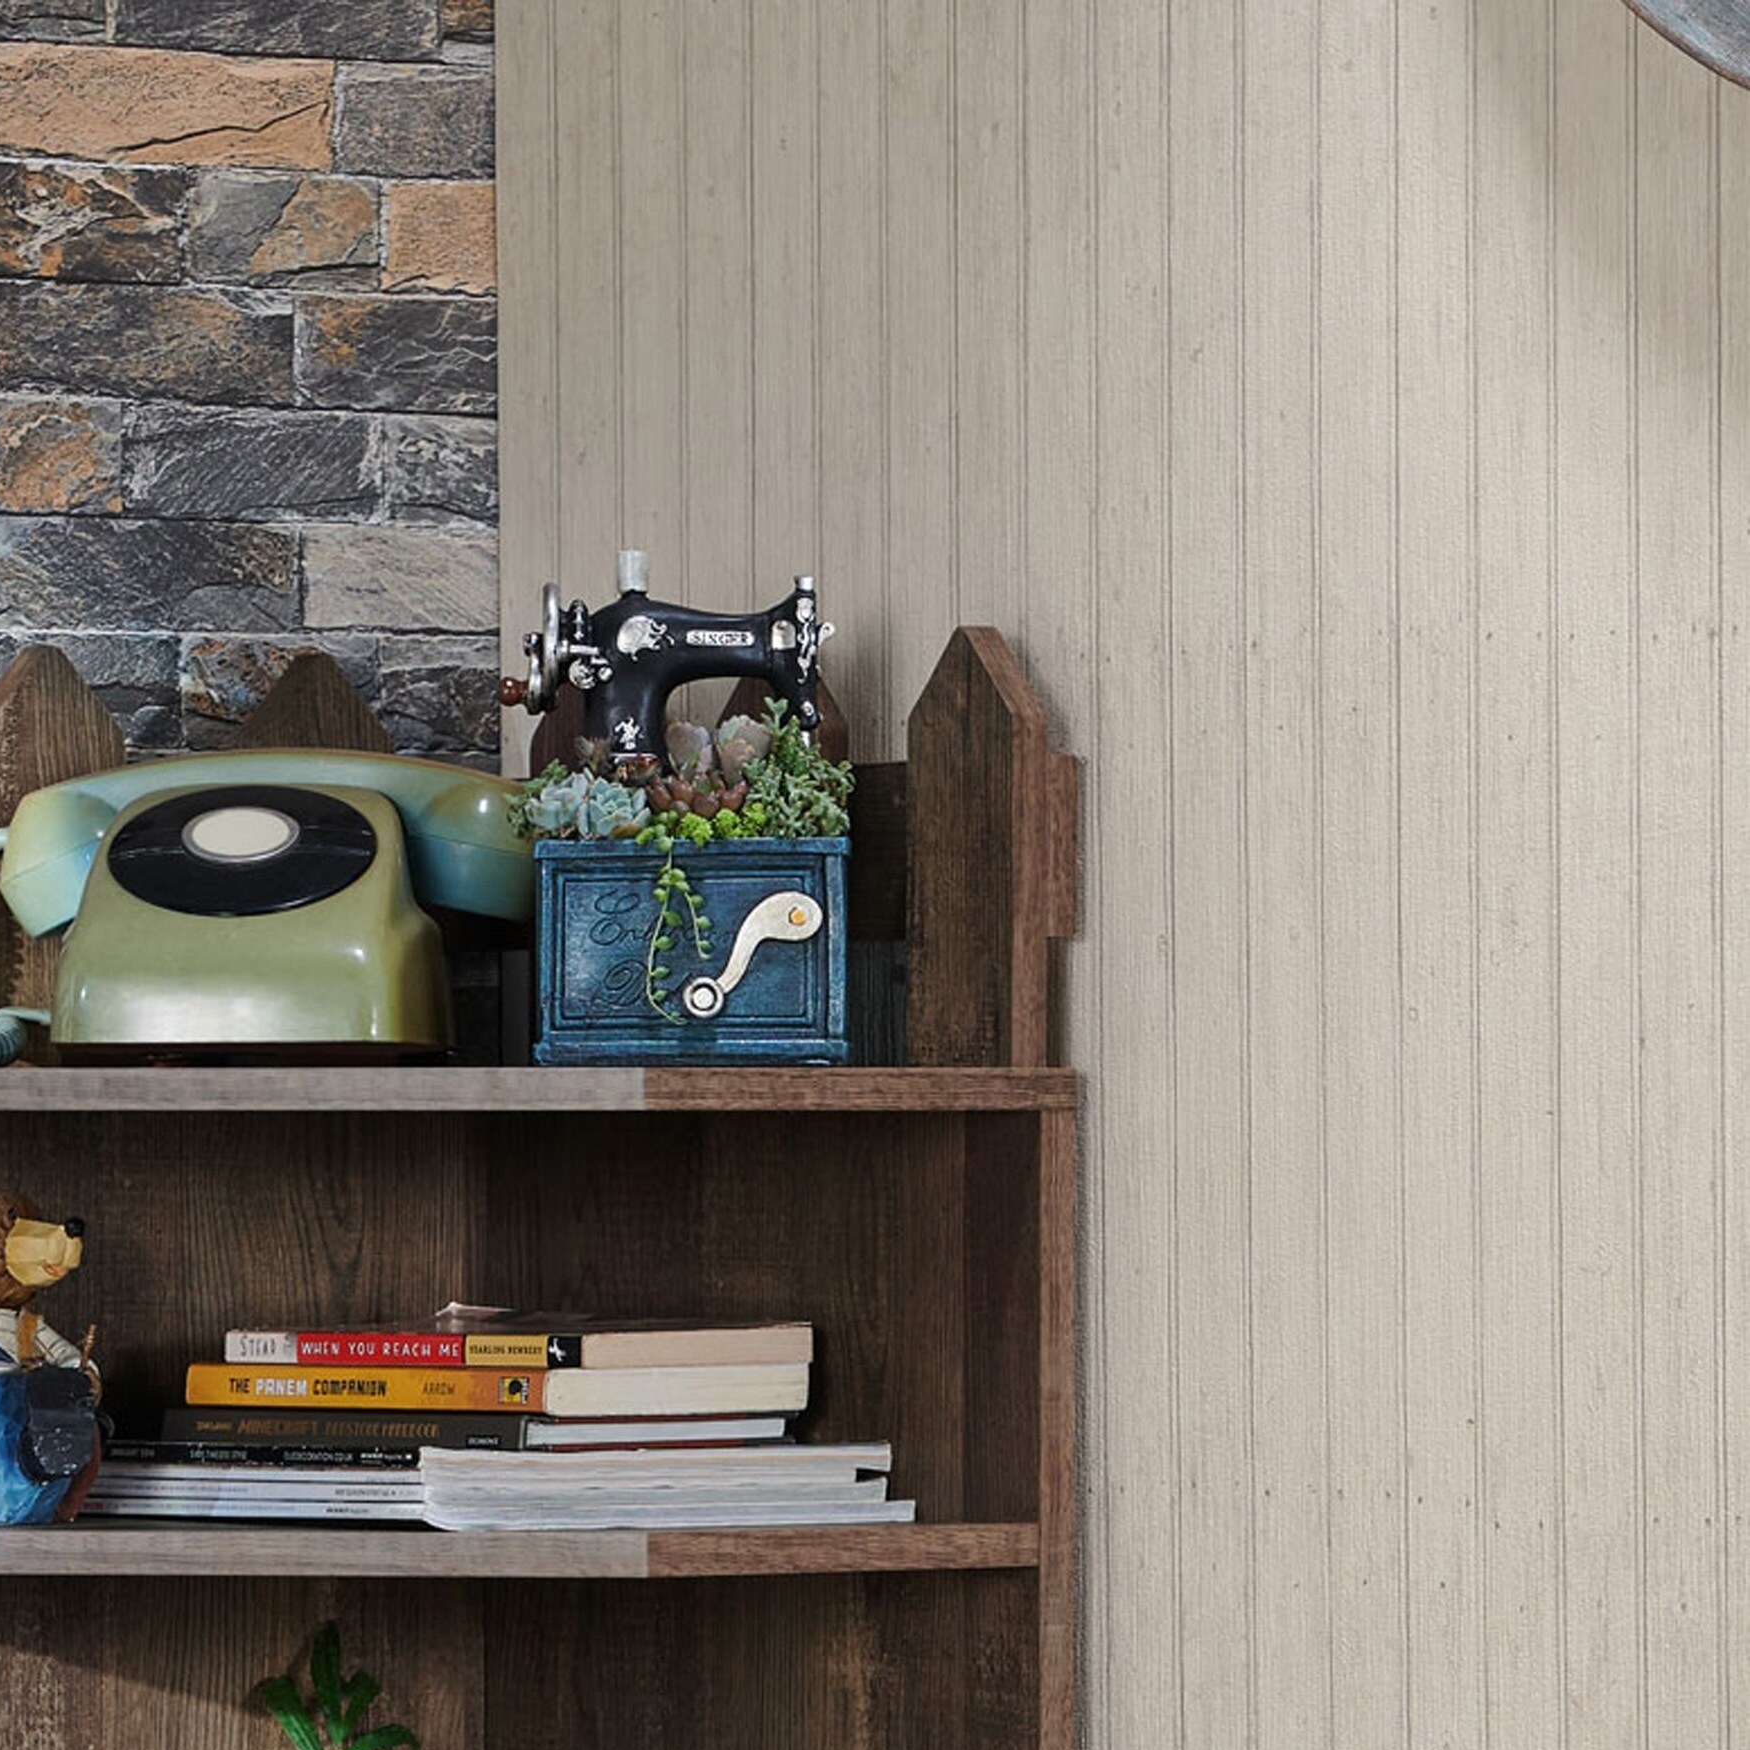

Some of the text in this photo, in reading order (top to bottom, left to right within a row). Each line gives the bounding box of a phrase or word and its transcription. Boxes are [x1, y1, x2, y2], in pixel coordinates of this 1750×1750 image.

[301, 1341, 460, 1357] WHEN YOU REACH ME
[229, 1377, 389, 1397] THE PANEM COMPANION
